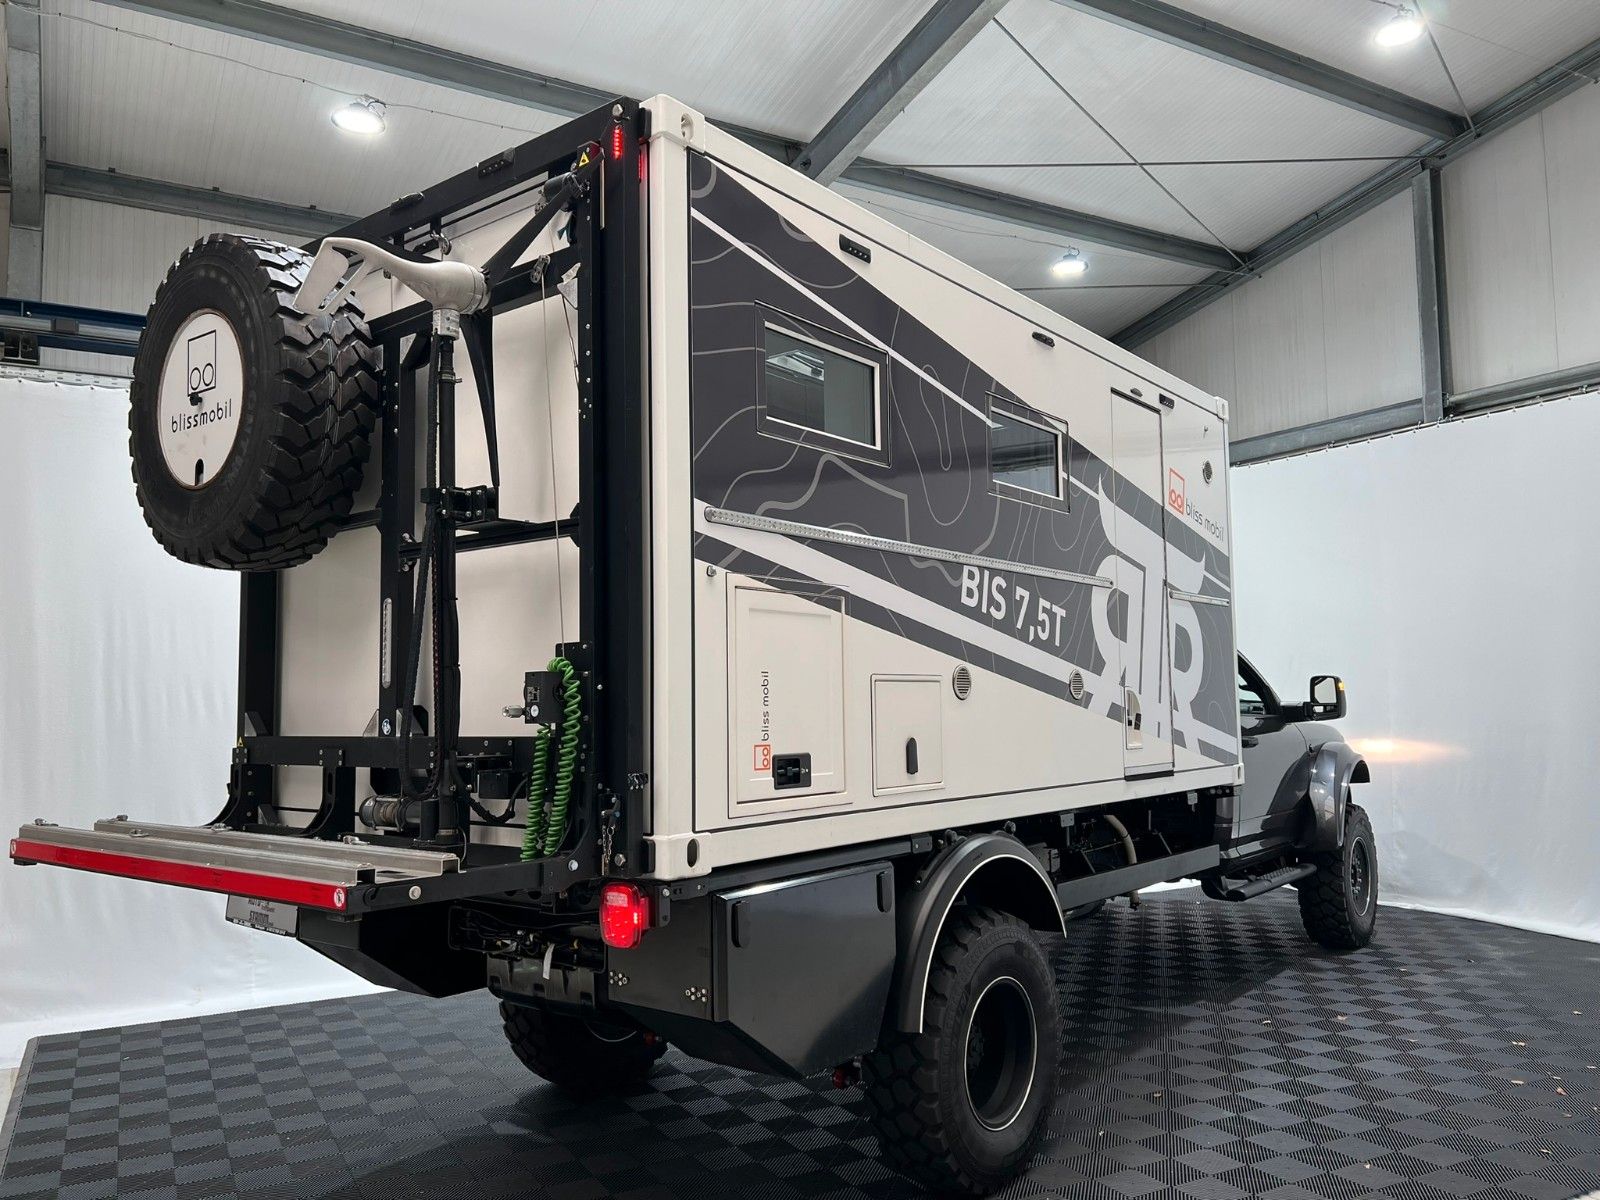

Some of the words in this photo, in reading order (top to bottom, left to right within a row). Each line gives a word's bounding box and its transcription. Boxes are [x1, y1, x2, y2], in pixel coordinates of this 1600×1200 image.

[171, 398, 232, 433] blissmobil
[1185, 498, 1203, 526] bliss
[1204, 517, 1224, 542] mobil
[960, 564, 1007, 620] BIS
[1015, 585, 1067, 647] 7,5T
[761, 670, 770, 707] mobil
[761, 710, 770, 741] bliss
